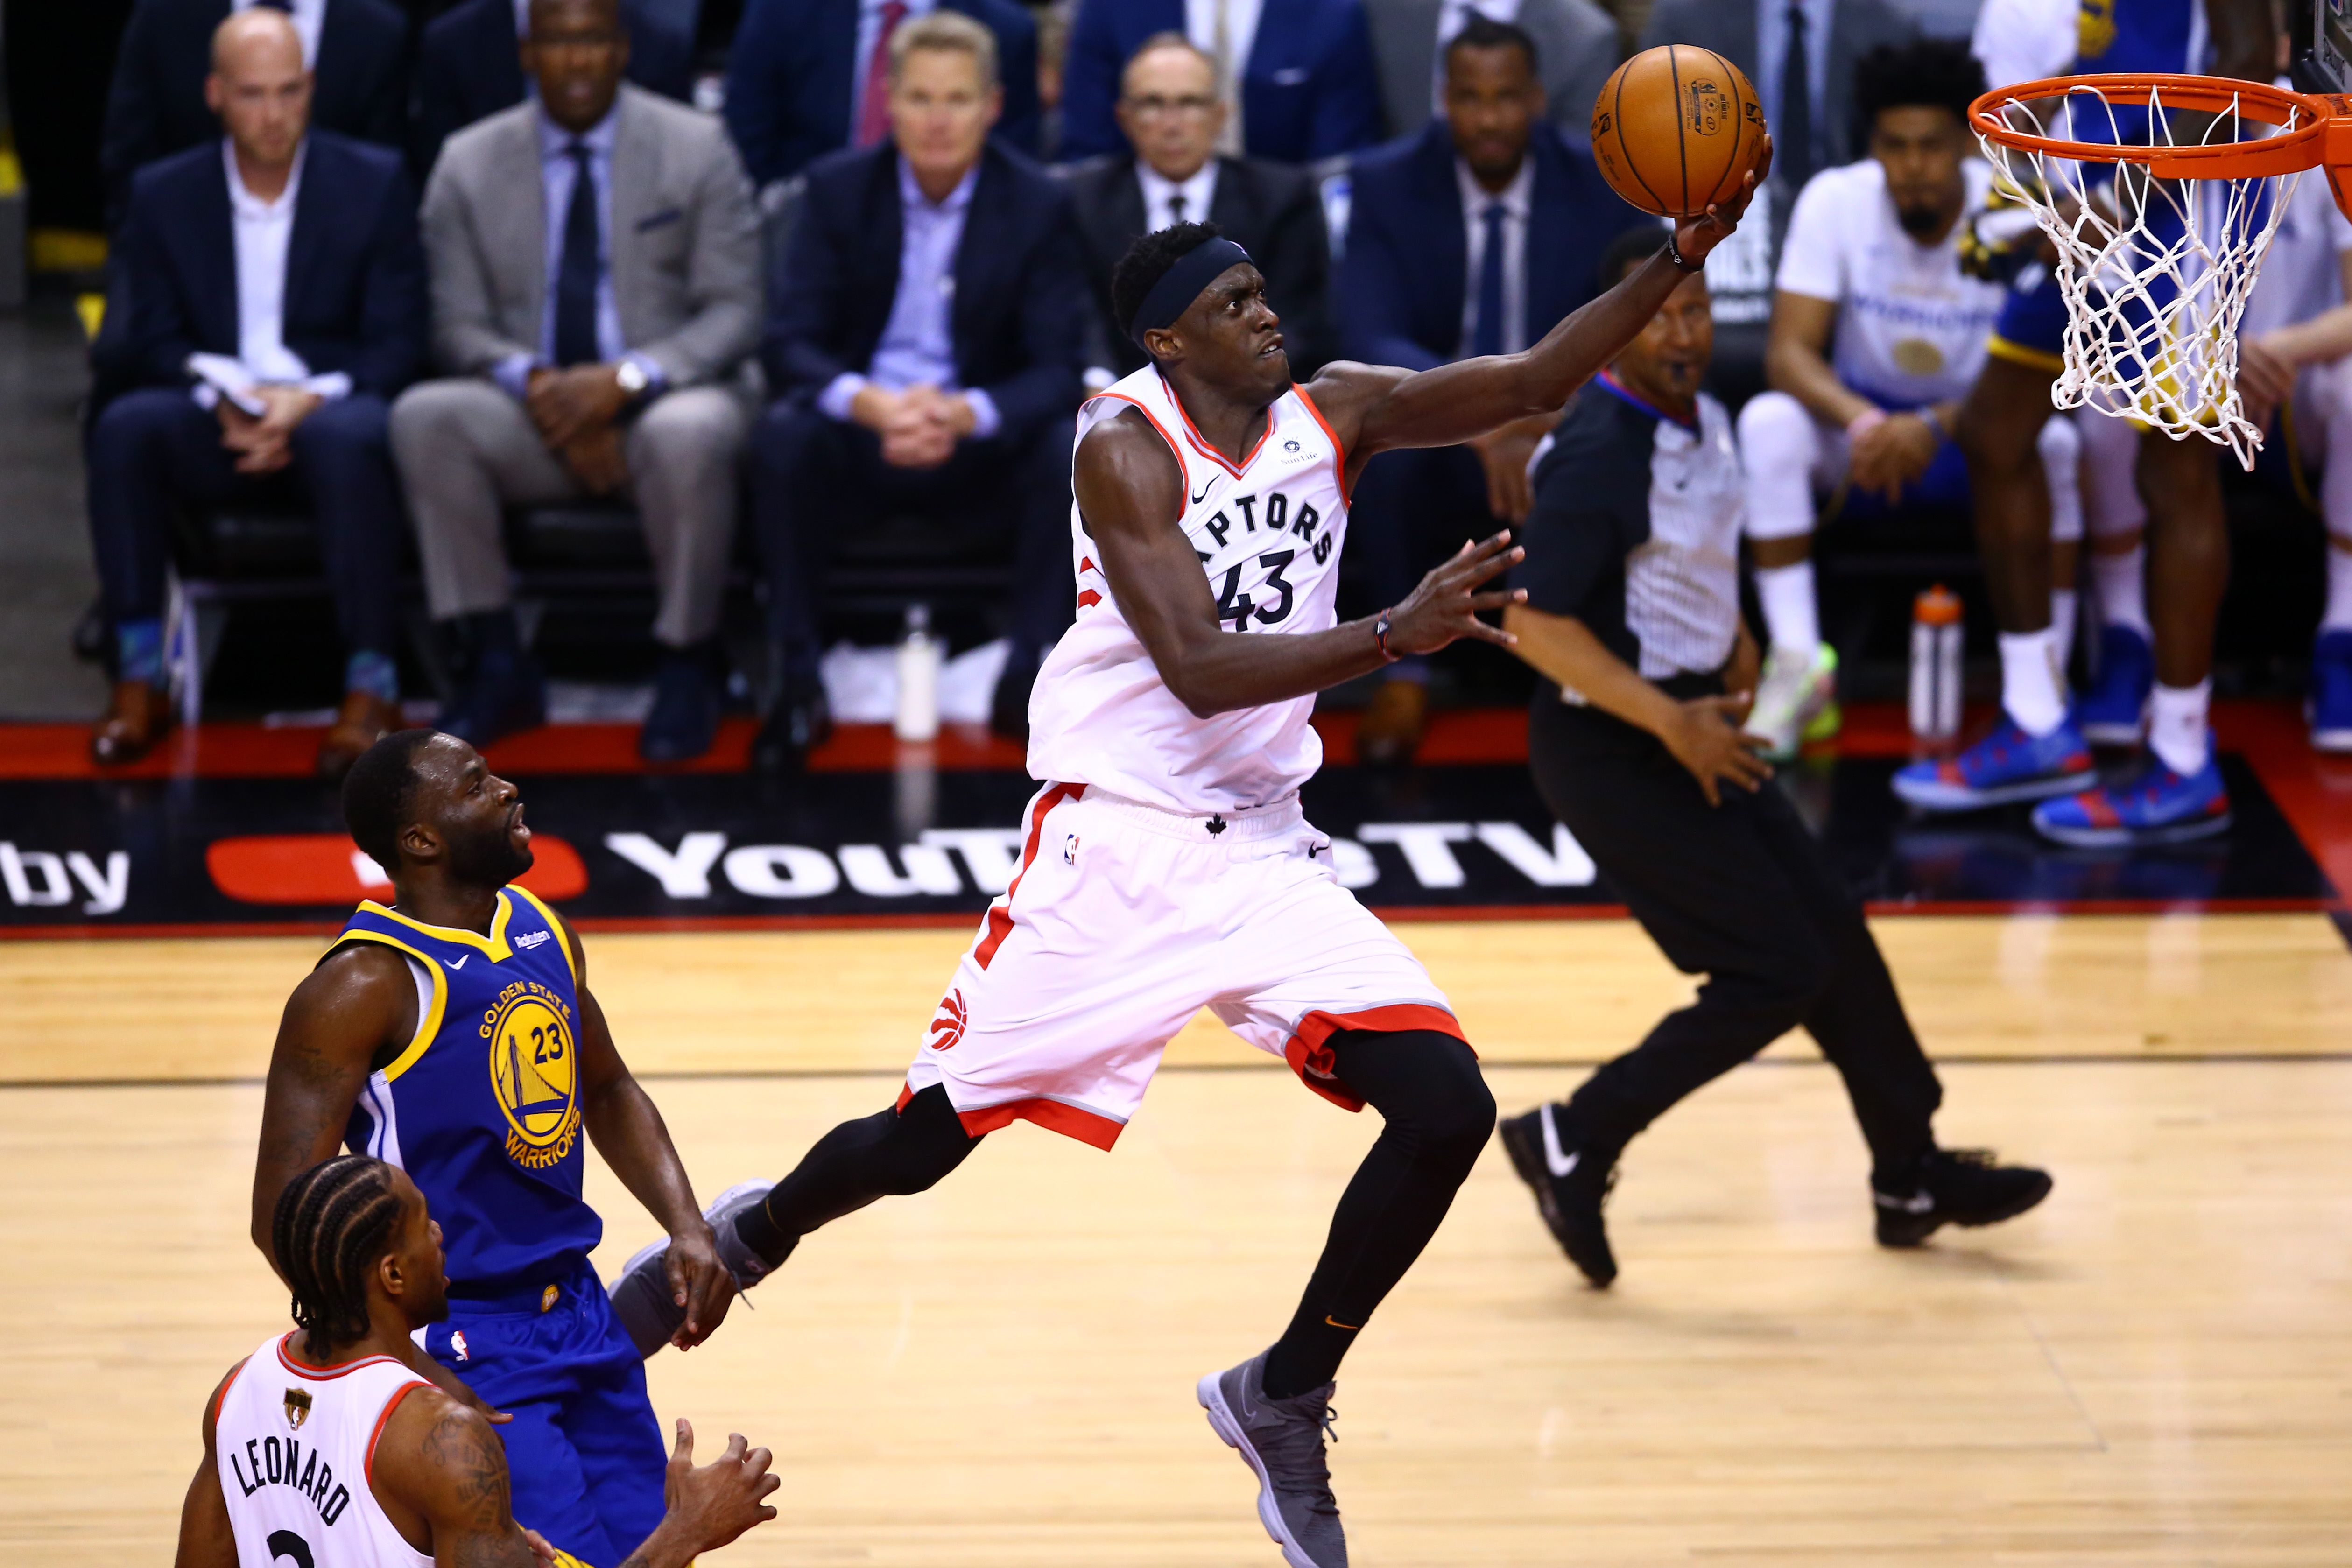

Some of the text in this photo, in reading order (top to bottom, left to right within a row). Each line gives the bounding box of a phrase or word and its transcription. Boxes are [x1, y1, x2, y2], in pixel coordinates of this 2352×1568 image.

[1281, 451, 1319, 465] Sun Life
[1196, 492, 1332, 567] PTORS
[1217, 549, 1295, 633] 43
[0, 840, 131, 916] by
[514, 930, 551, 949] Rakuten
[479, 981, 572, 1039] GOLDEN STATE
[531, 1022, 563, 1065] 23
[505, 1106, 581, 1169] WARRIORS
[230, 1435, 350, 1527] LEONARD
